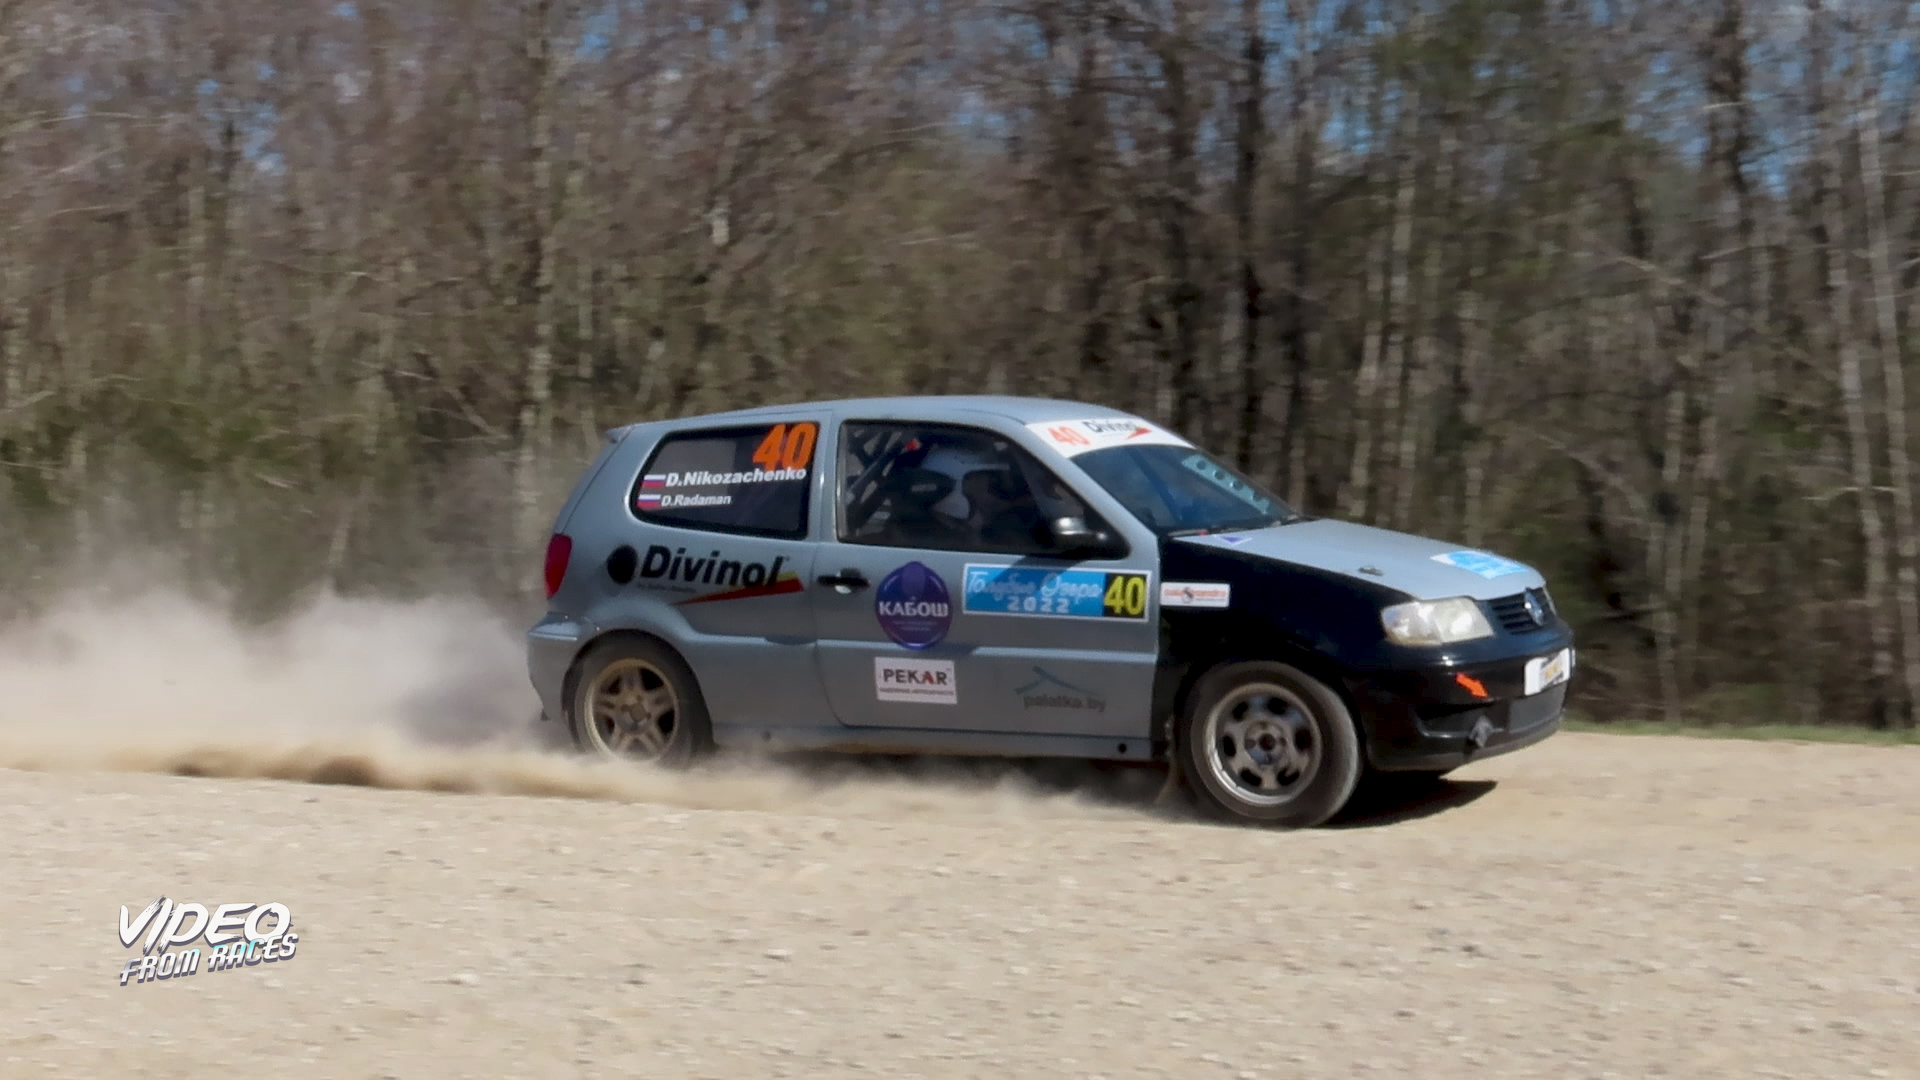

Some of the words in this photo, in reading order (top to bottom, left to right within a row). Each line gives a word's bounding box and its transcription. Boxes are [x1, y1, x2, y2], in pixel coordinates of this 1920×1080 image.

[752, 422, 818, 471] 40
[665, 466, 807, 487] D.Nikozachenko
[661, 494, 732, 507] D.Radaman
[640, 544, 783, 588] Divinol
[1007, 596, 1071, 614] 2022
[1103, 575, 1147, 616] 40
[879, 600, 949, 617] КАБОШ
[882, 668, 948, 686] PEKAR
